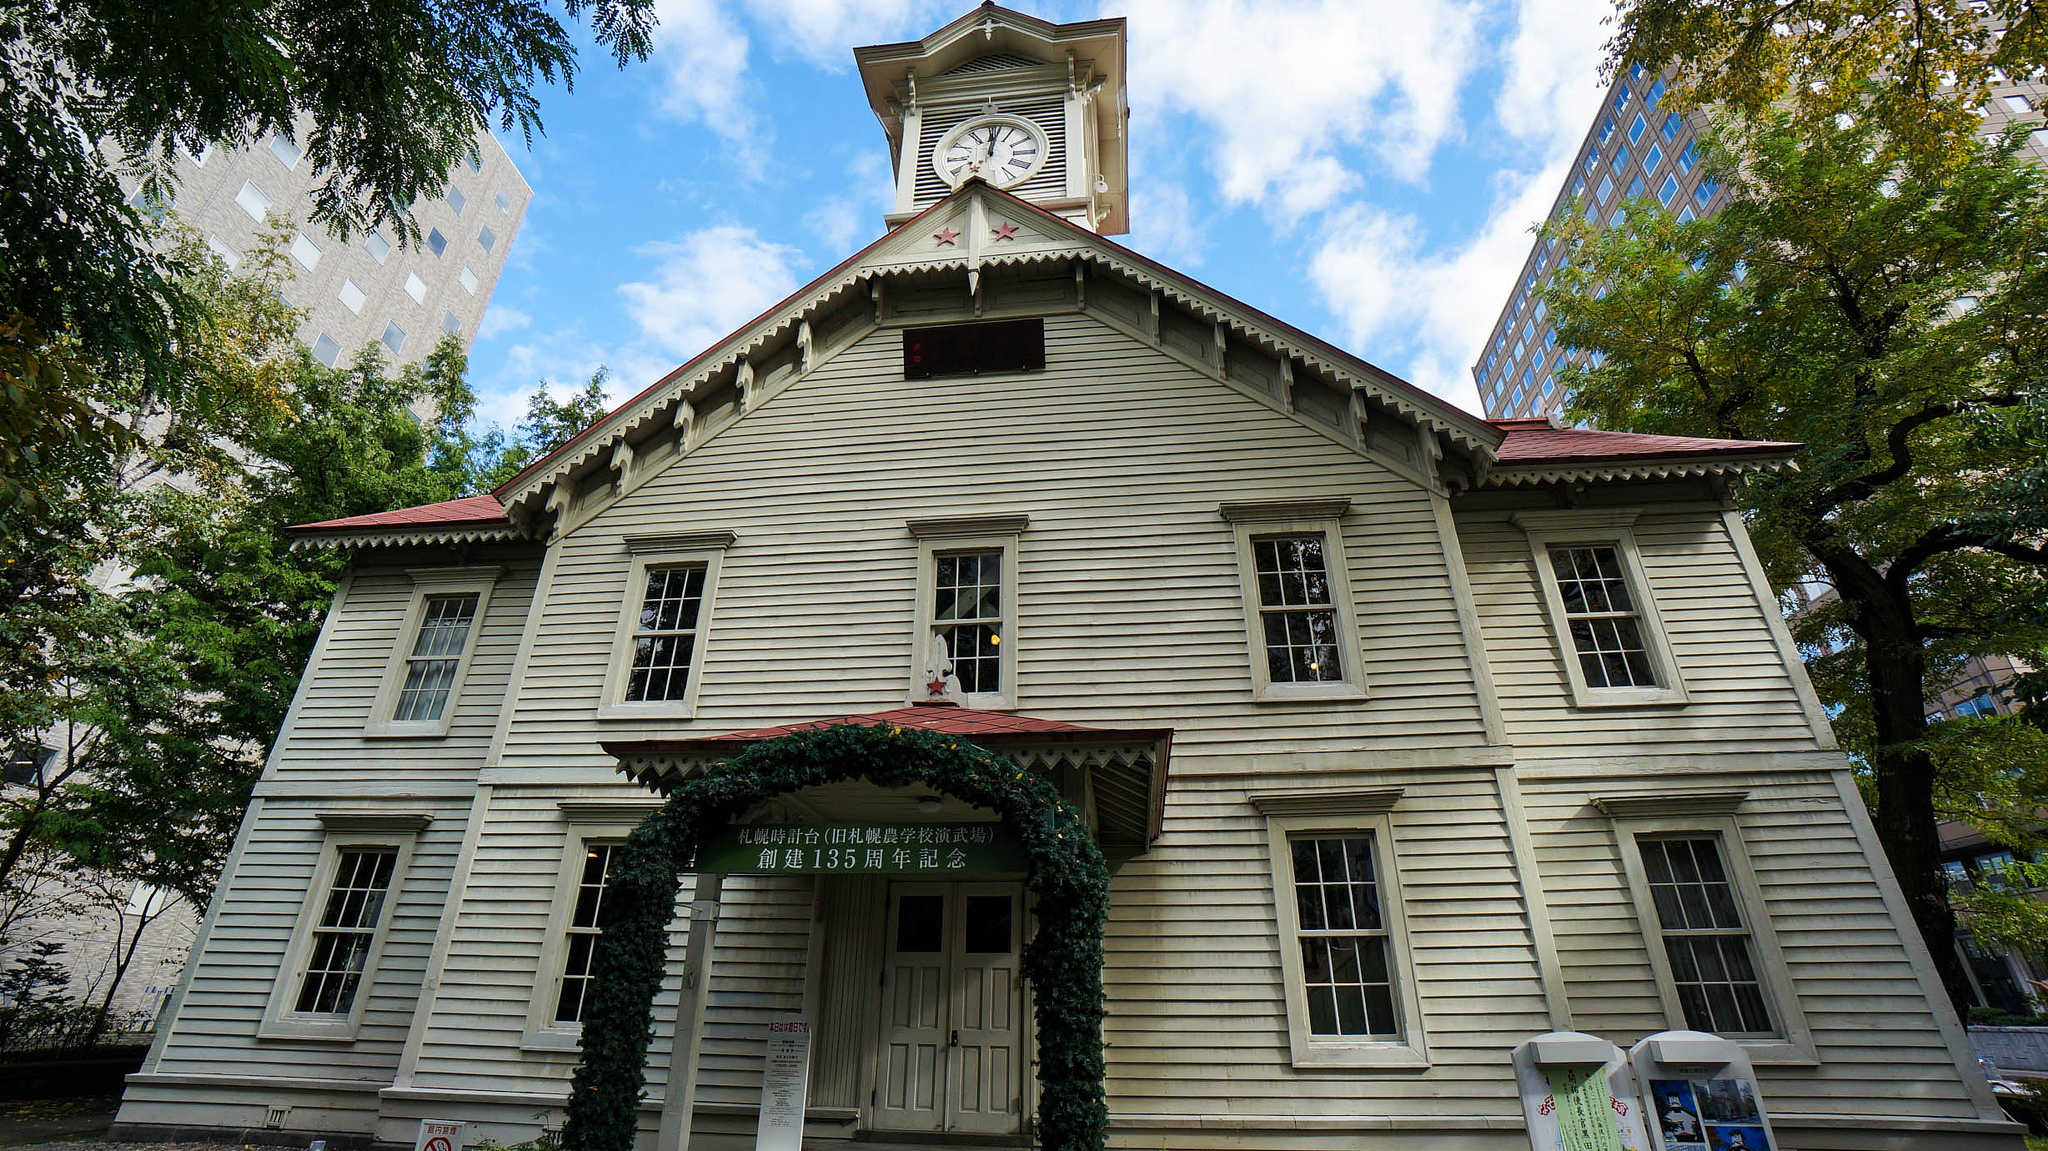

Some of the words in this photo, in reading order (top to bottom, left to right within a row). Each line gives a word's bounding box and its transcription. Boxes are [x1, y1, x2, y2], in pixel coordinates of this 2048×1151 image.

[737, 826, 995, 846] 札幌時計台(旧札幌農学校演武場)
[757, 848, 968, 870] 創建135周年記念
